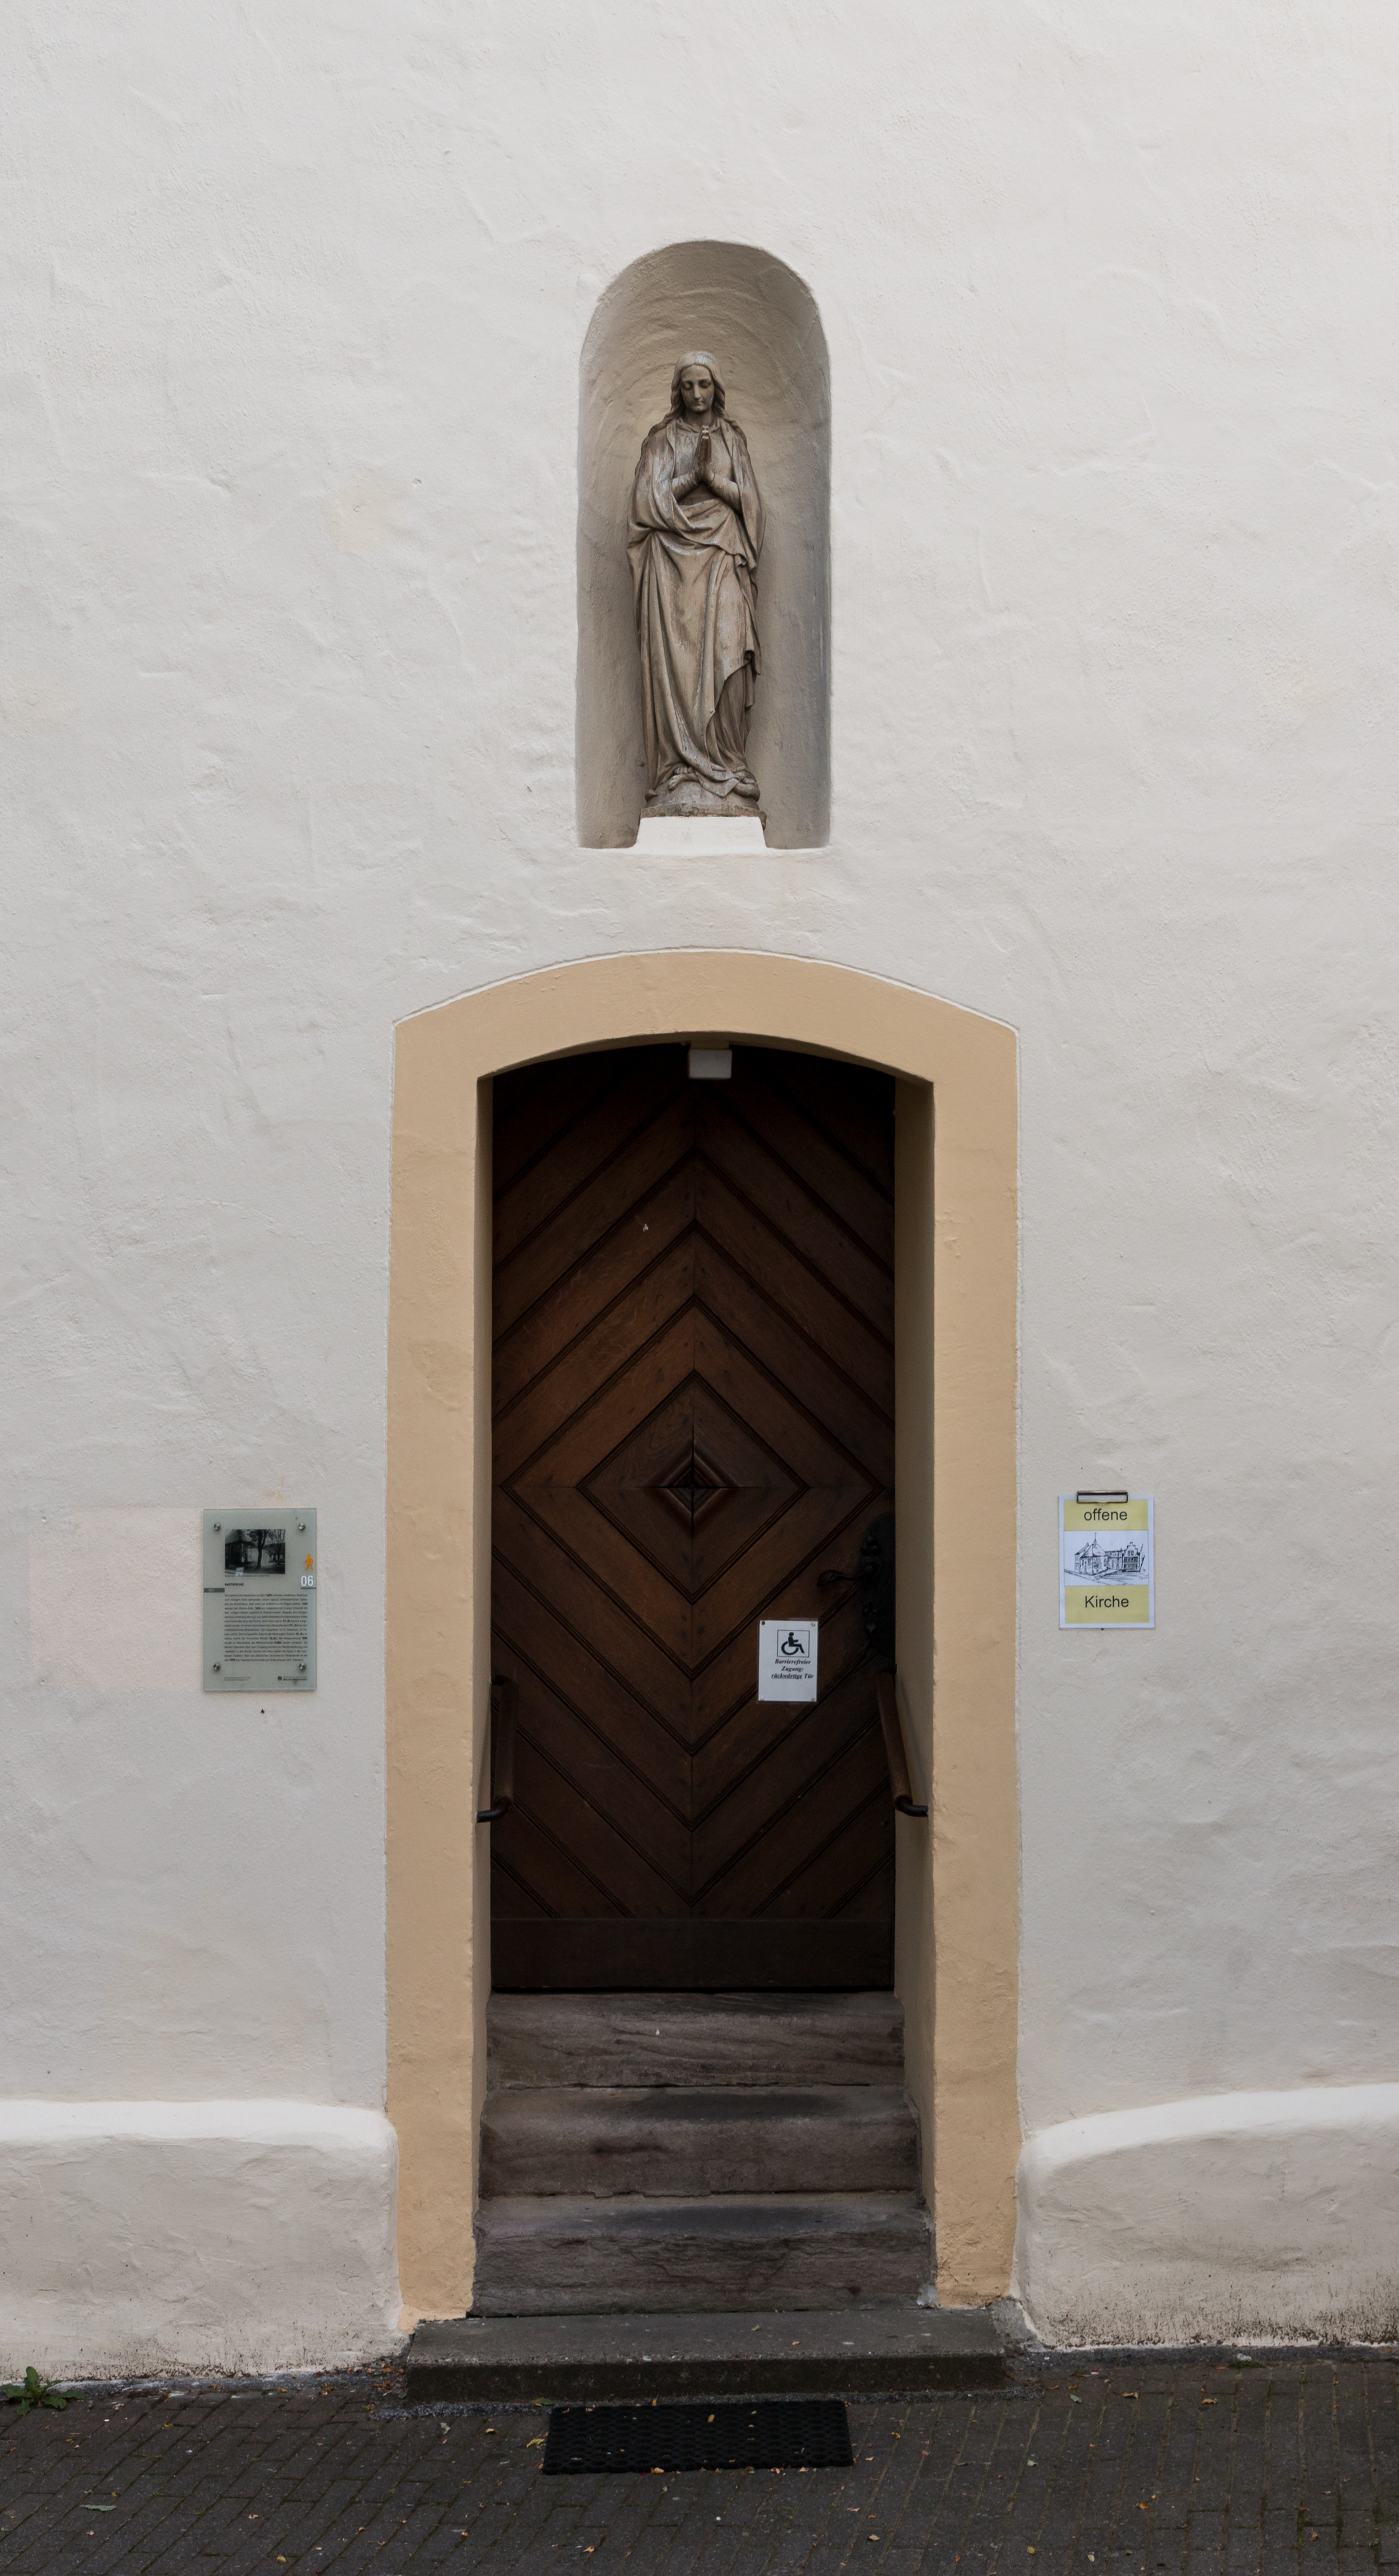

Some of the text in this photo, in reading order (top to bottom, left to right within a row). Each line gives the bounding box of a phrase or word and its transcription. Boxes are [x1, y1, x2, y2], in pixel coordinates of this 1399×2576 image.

[1084, 1508, 1128, 1521] offene
[301, 1575, 314, 1587] 06
[1085, 1595, 1129, 1608] Kirche
